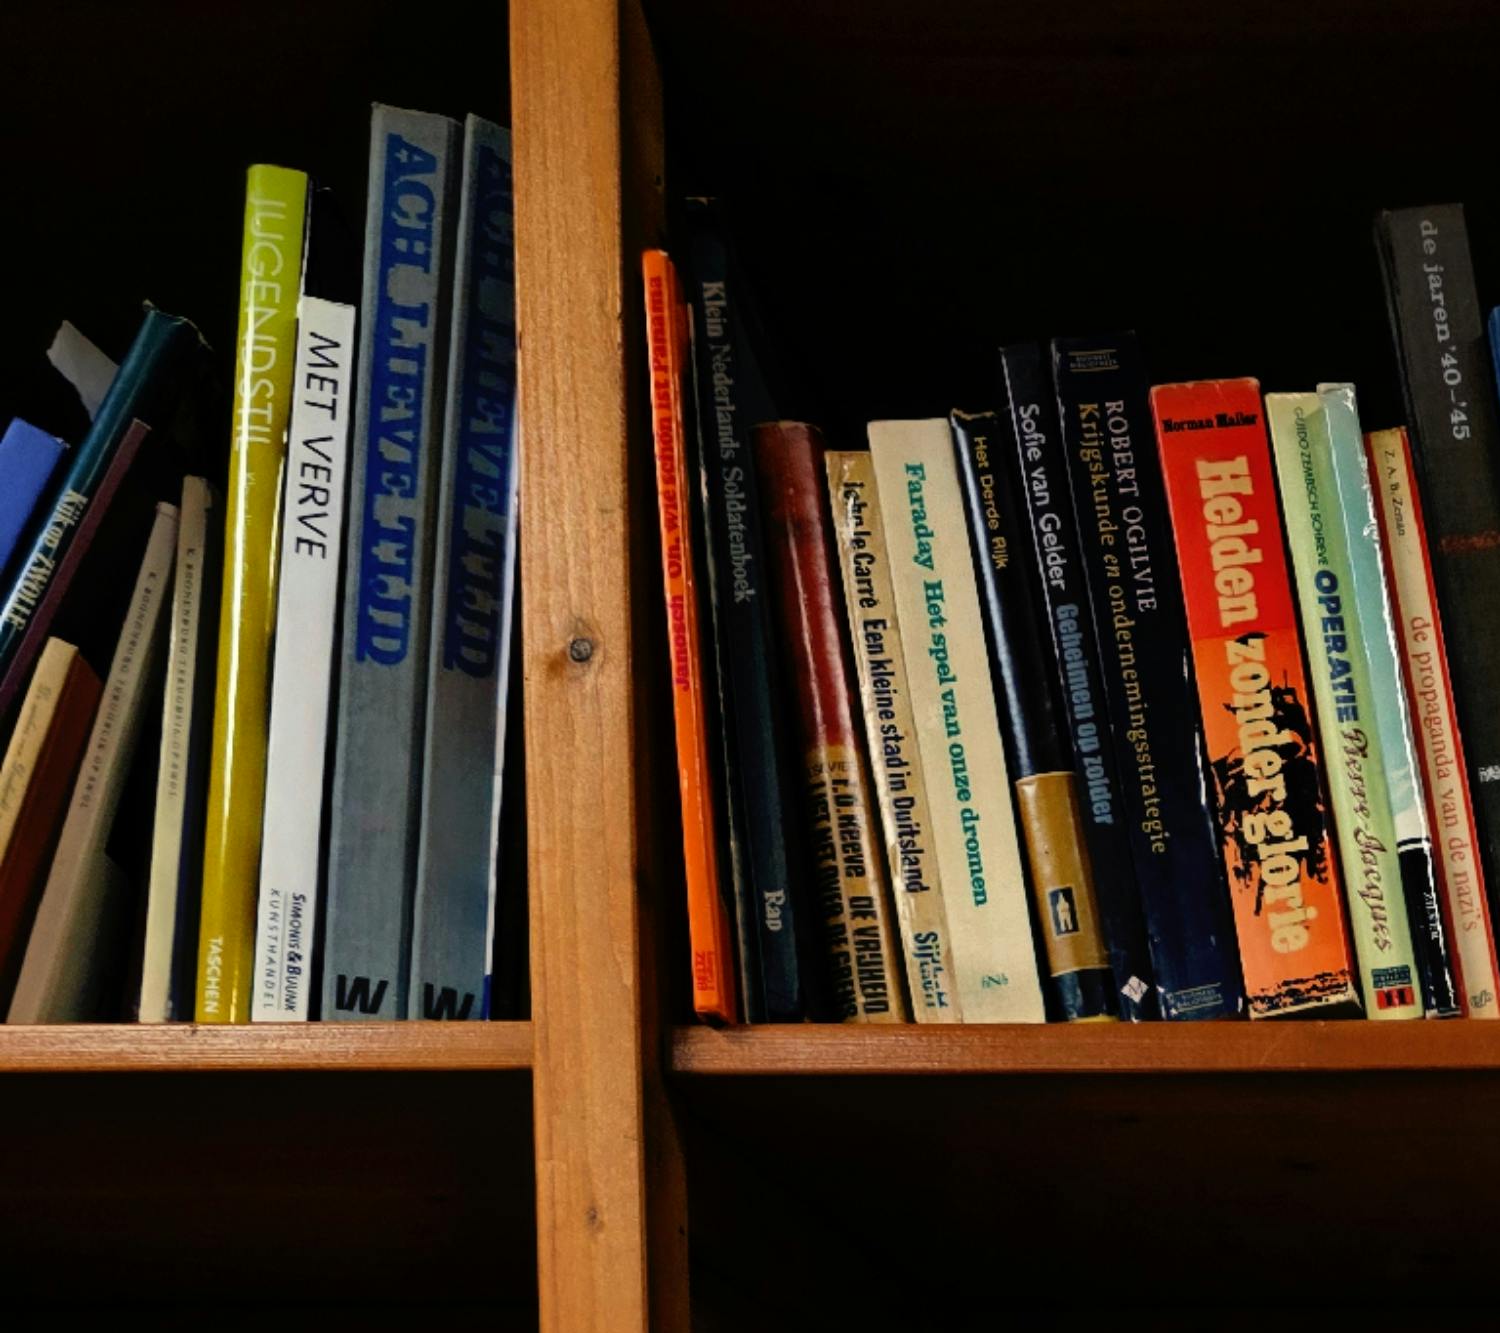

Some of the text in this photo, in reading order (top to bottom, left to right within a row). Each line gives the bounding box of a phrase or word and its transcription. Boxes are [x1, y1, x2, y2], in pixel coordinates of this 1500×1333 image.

[235, 197, 287, 450] JUGENDSTIL
[296, 332, 341, 560] MET VERVE
[356, 133, 438, 665] ACH LIEVE TIJD
[1077, 402, 1119, 546] Krijgskunde
[1104, 553, 1123, 580] en
[904, 461, 991, 908] Faraday Het spel van onze dromen
[1110, 586, 1169, 854] ondernemingsstrategie
[1194, 456, 1318, 953] Helden zonder glorie
[203, 935, 226, 1013] TASCHEN
